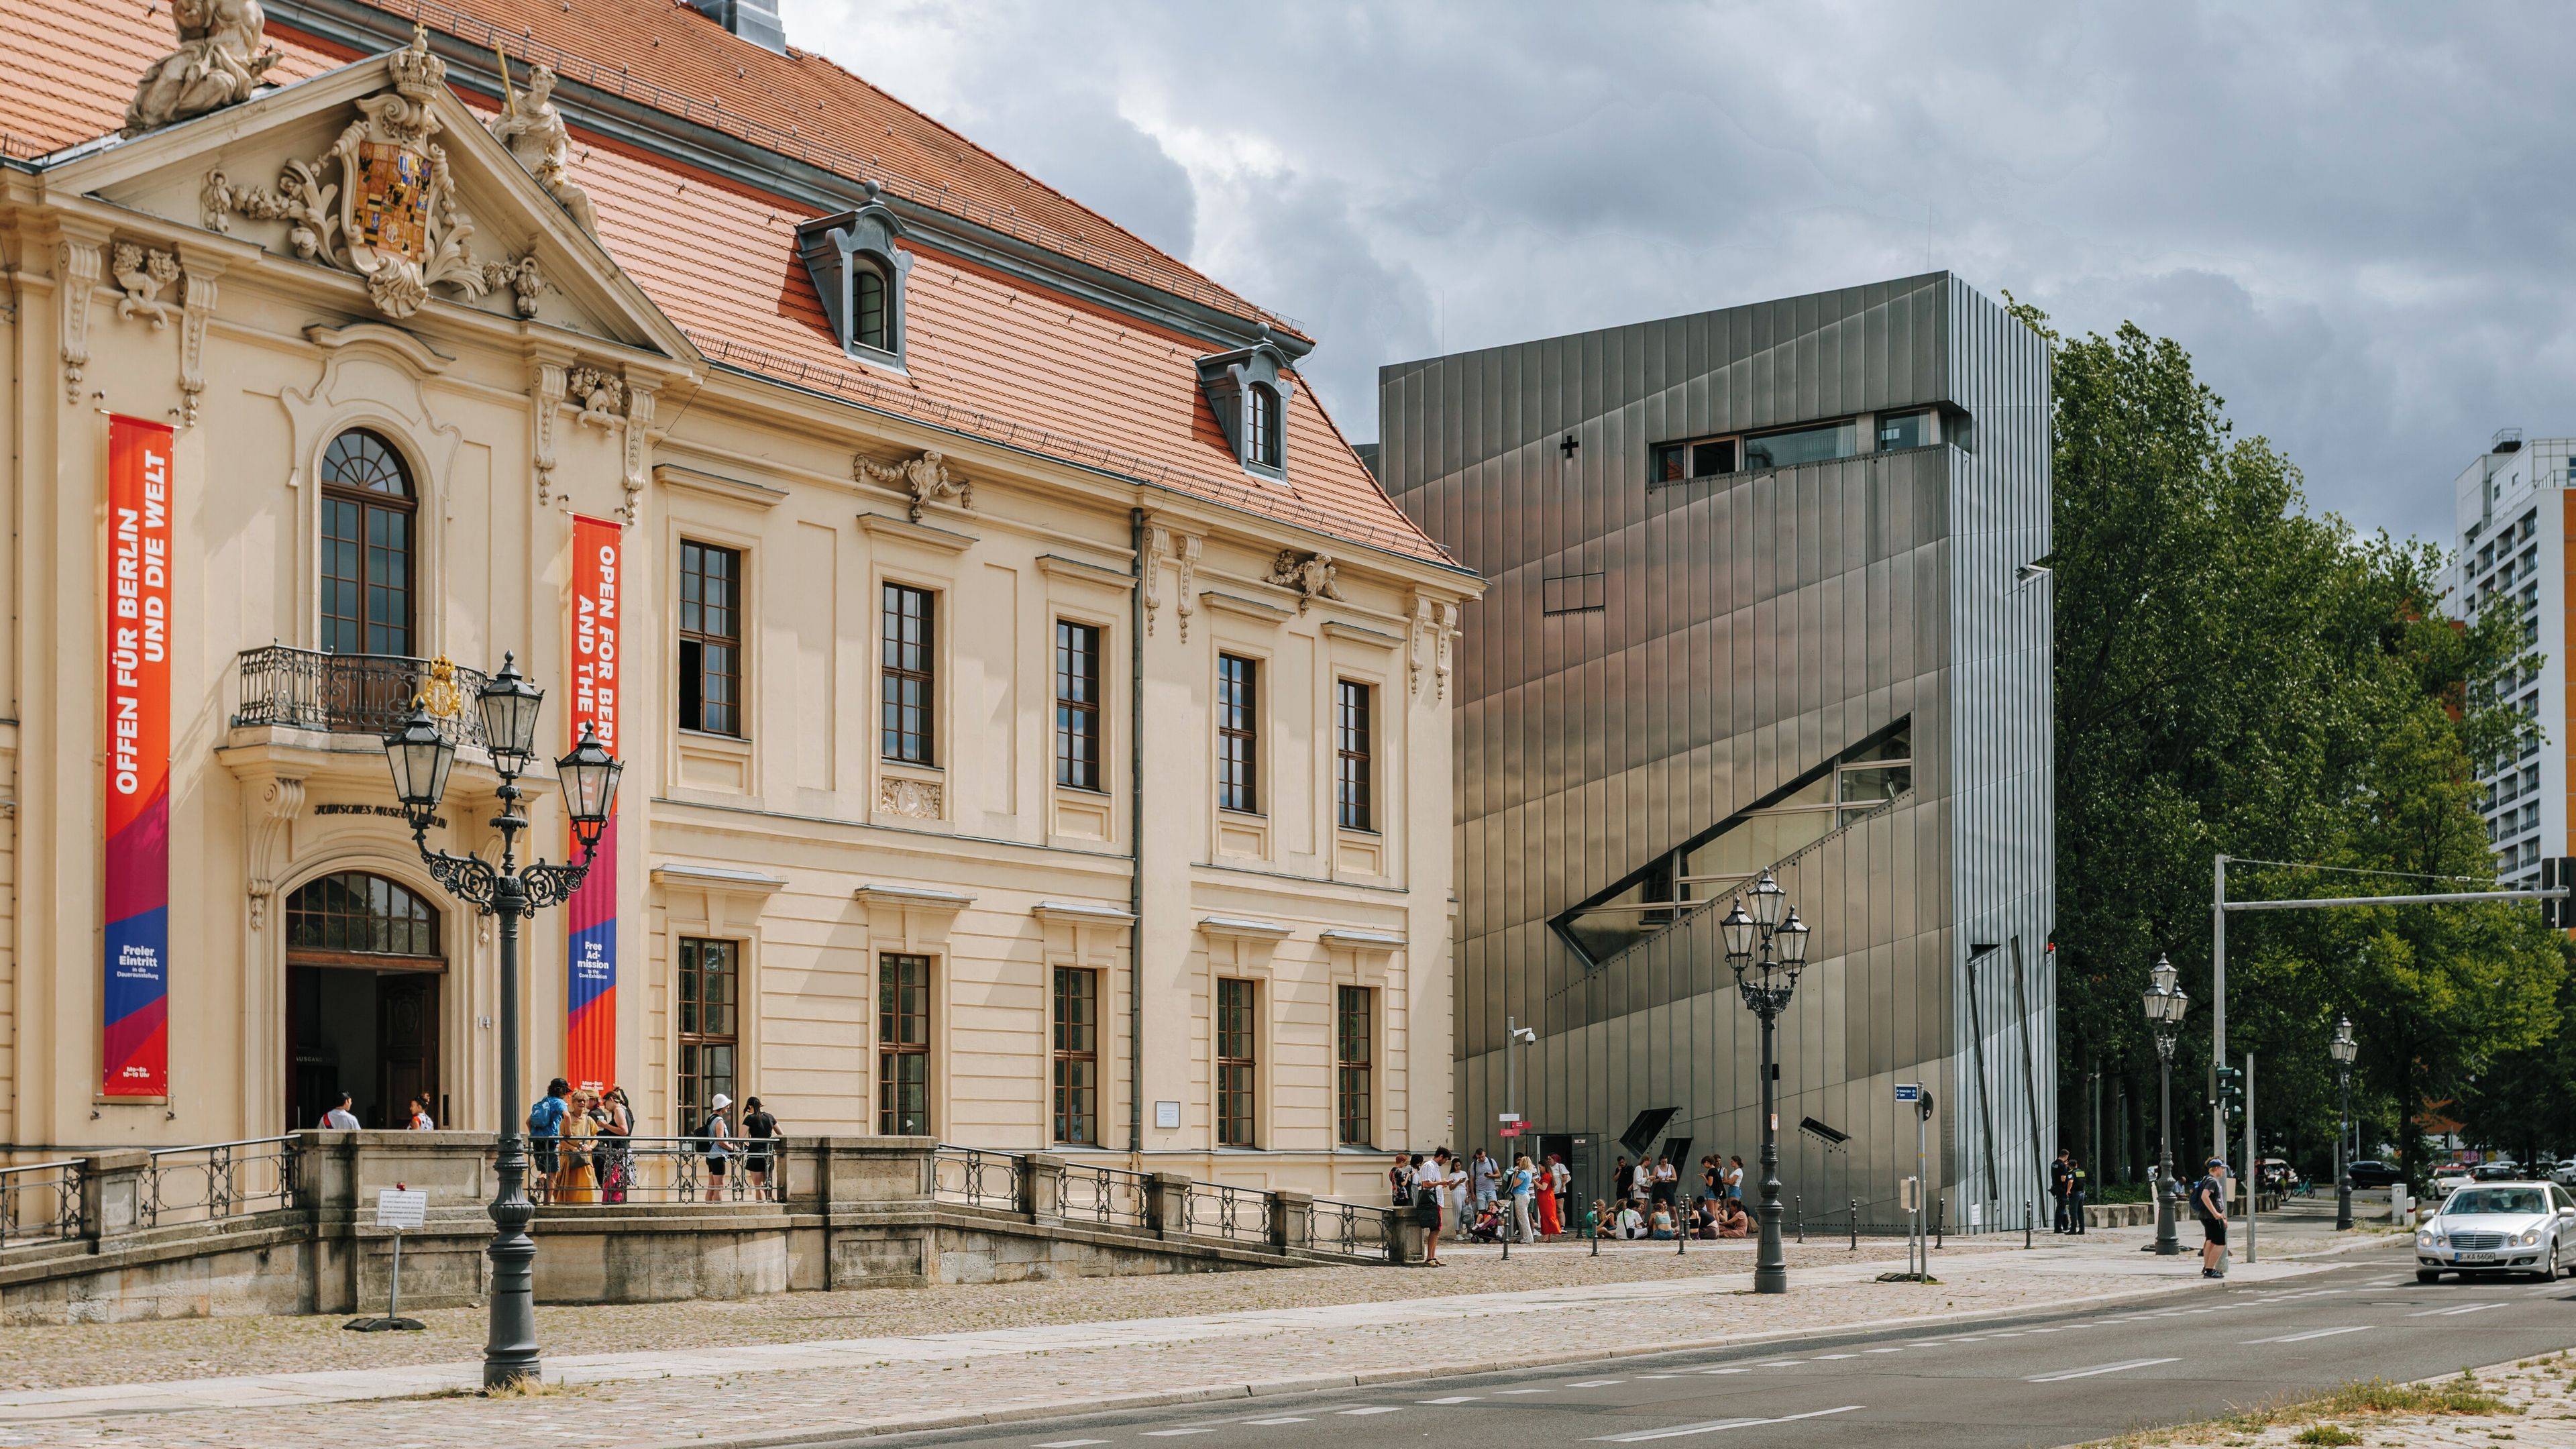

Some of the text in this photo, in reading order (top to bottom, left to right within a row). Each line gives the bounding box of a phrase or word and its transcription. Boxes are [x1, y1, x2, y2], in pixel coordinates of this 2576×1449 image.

[145, 449, 165, 662] UND DIE WELT
[599, 545, 615, 619] OPEN
[578, 594, 594, 655] AND
[112, 508, 138, 794] OFFEN FÜR BERLIN
[598, 625, 614, 680] FOR
[578, 662, 594, 713] THE
[119, 955, 158, 967] Eintritt
[123, 945, 154, 956] Freier
[577, 959, 609, 969] mission
[585, 941, 602, 951] Free
[586, 951, 601, 959] Ad-
